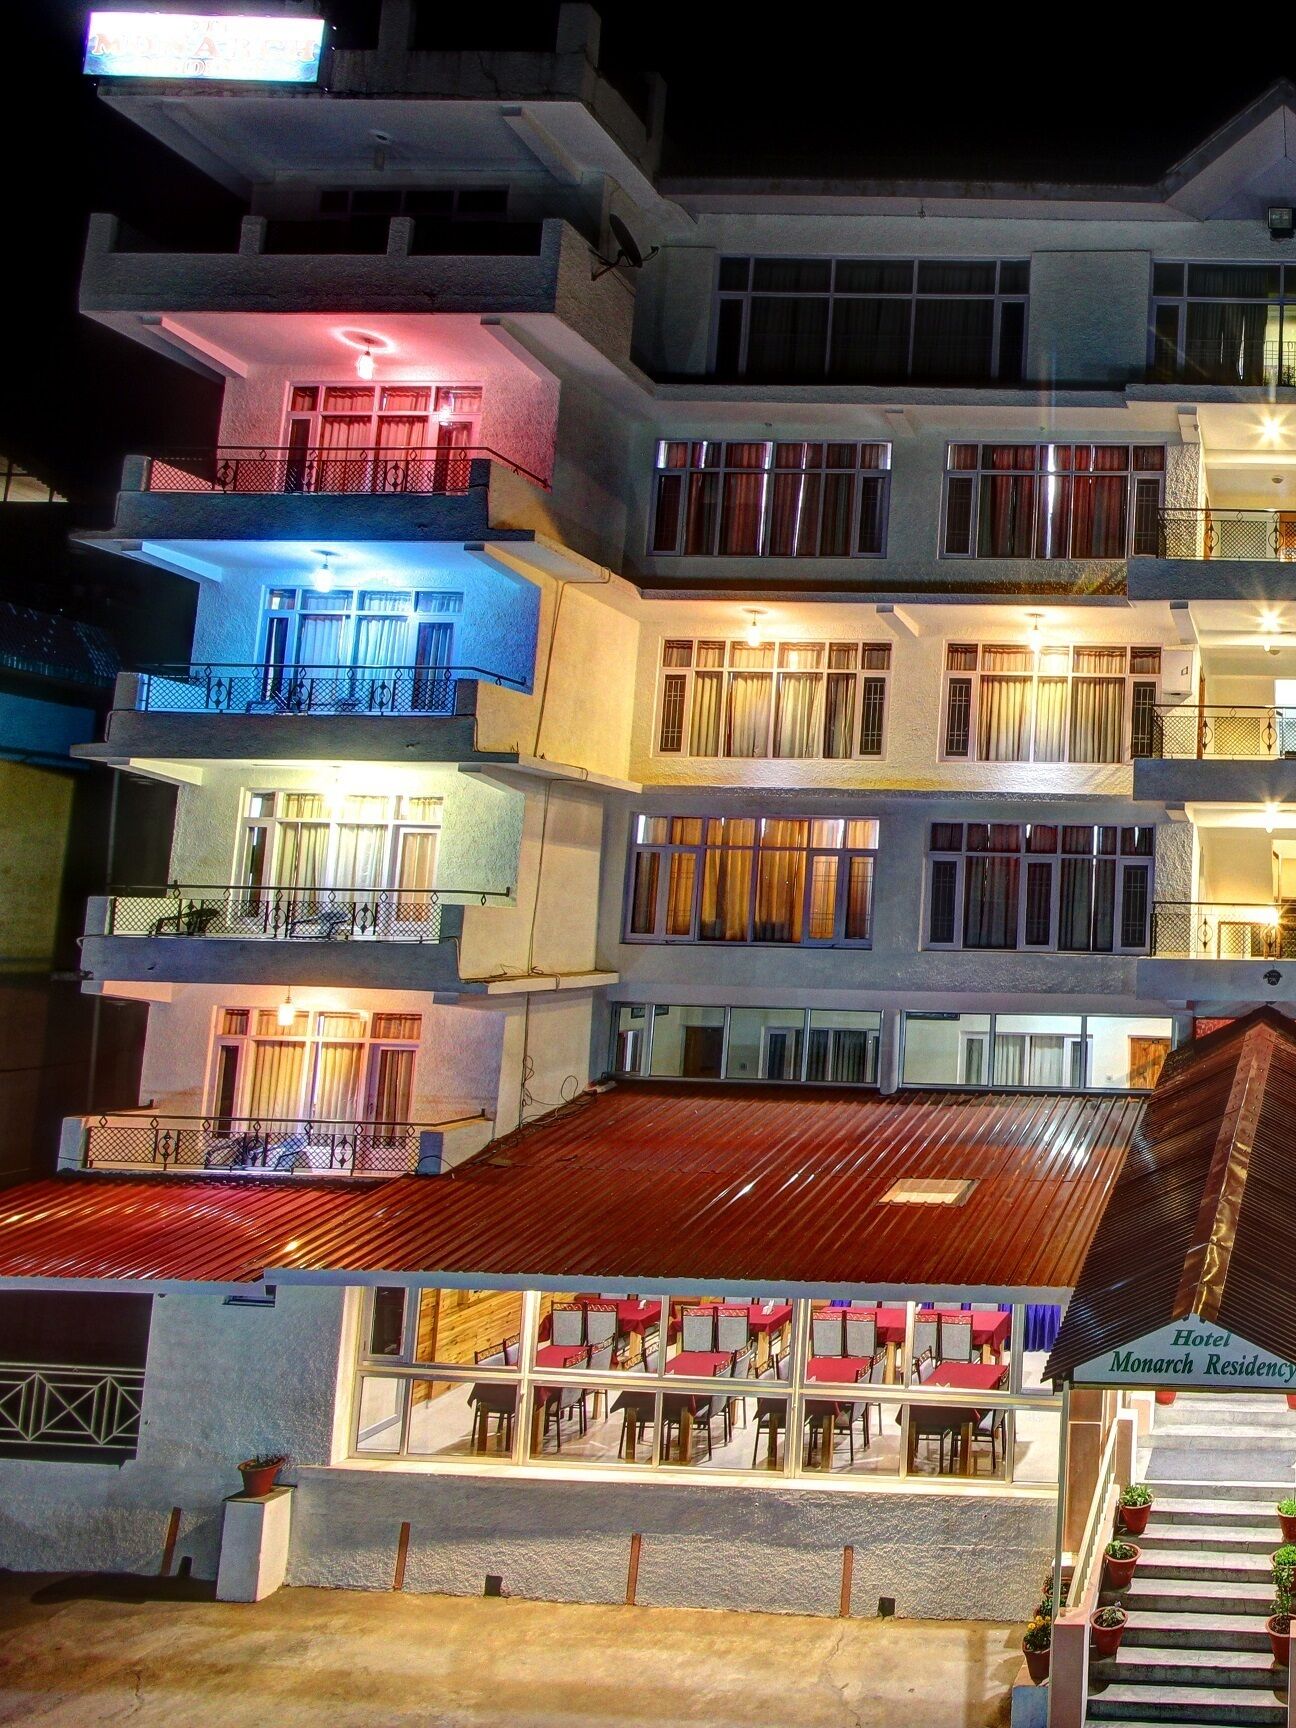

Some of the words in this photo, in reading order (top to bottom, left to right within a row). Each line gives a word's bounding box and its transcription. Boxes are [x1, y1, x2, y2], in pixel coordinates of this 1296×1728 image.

[1169, 1329, 1231, 1347] Hotel
[1108, 1351, 1193, 1374] Monarch
[1203, 1353, 1296, 1383] Residency
